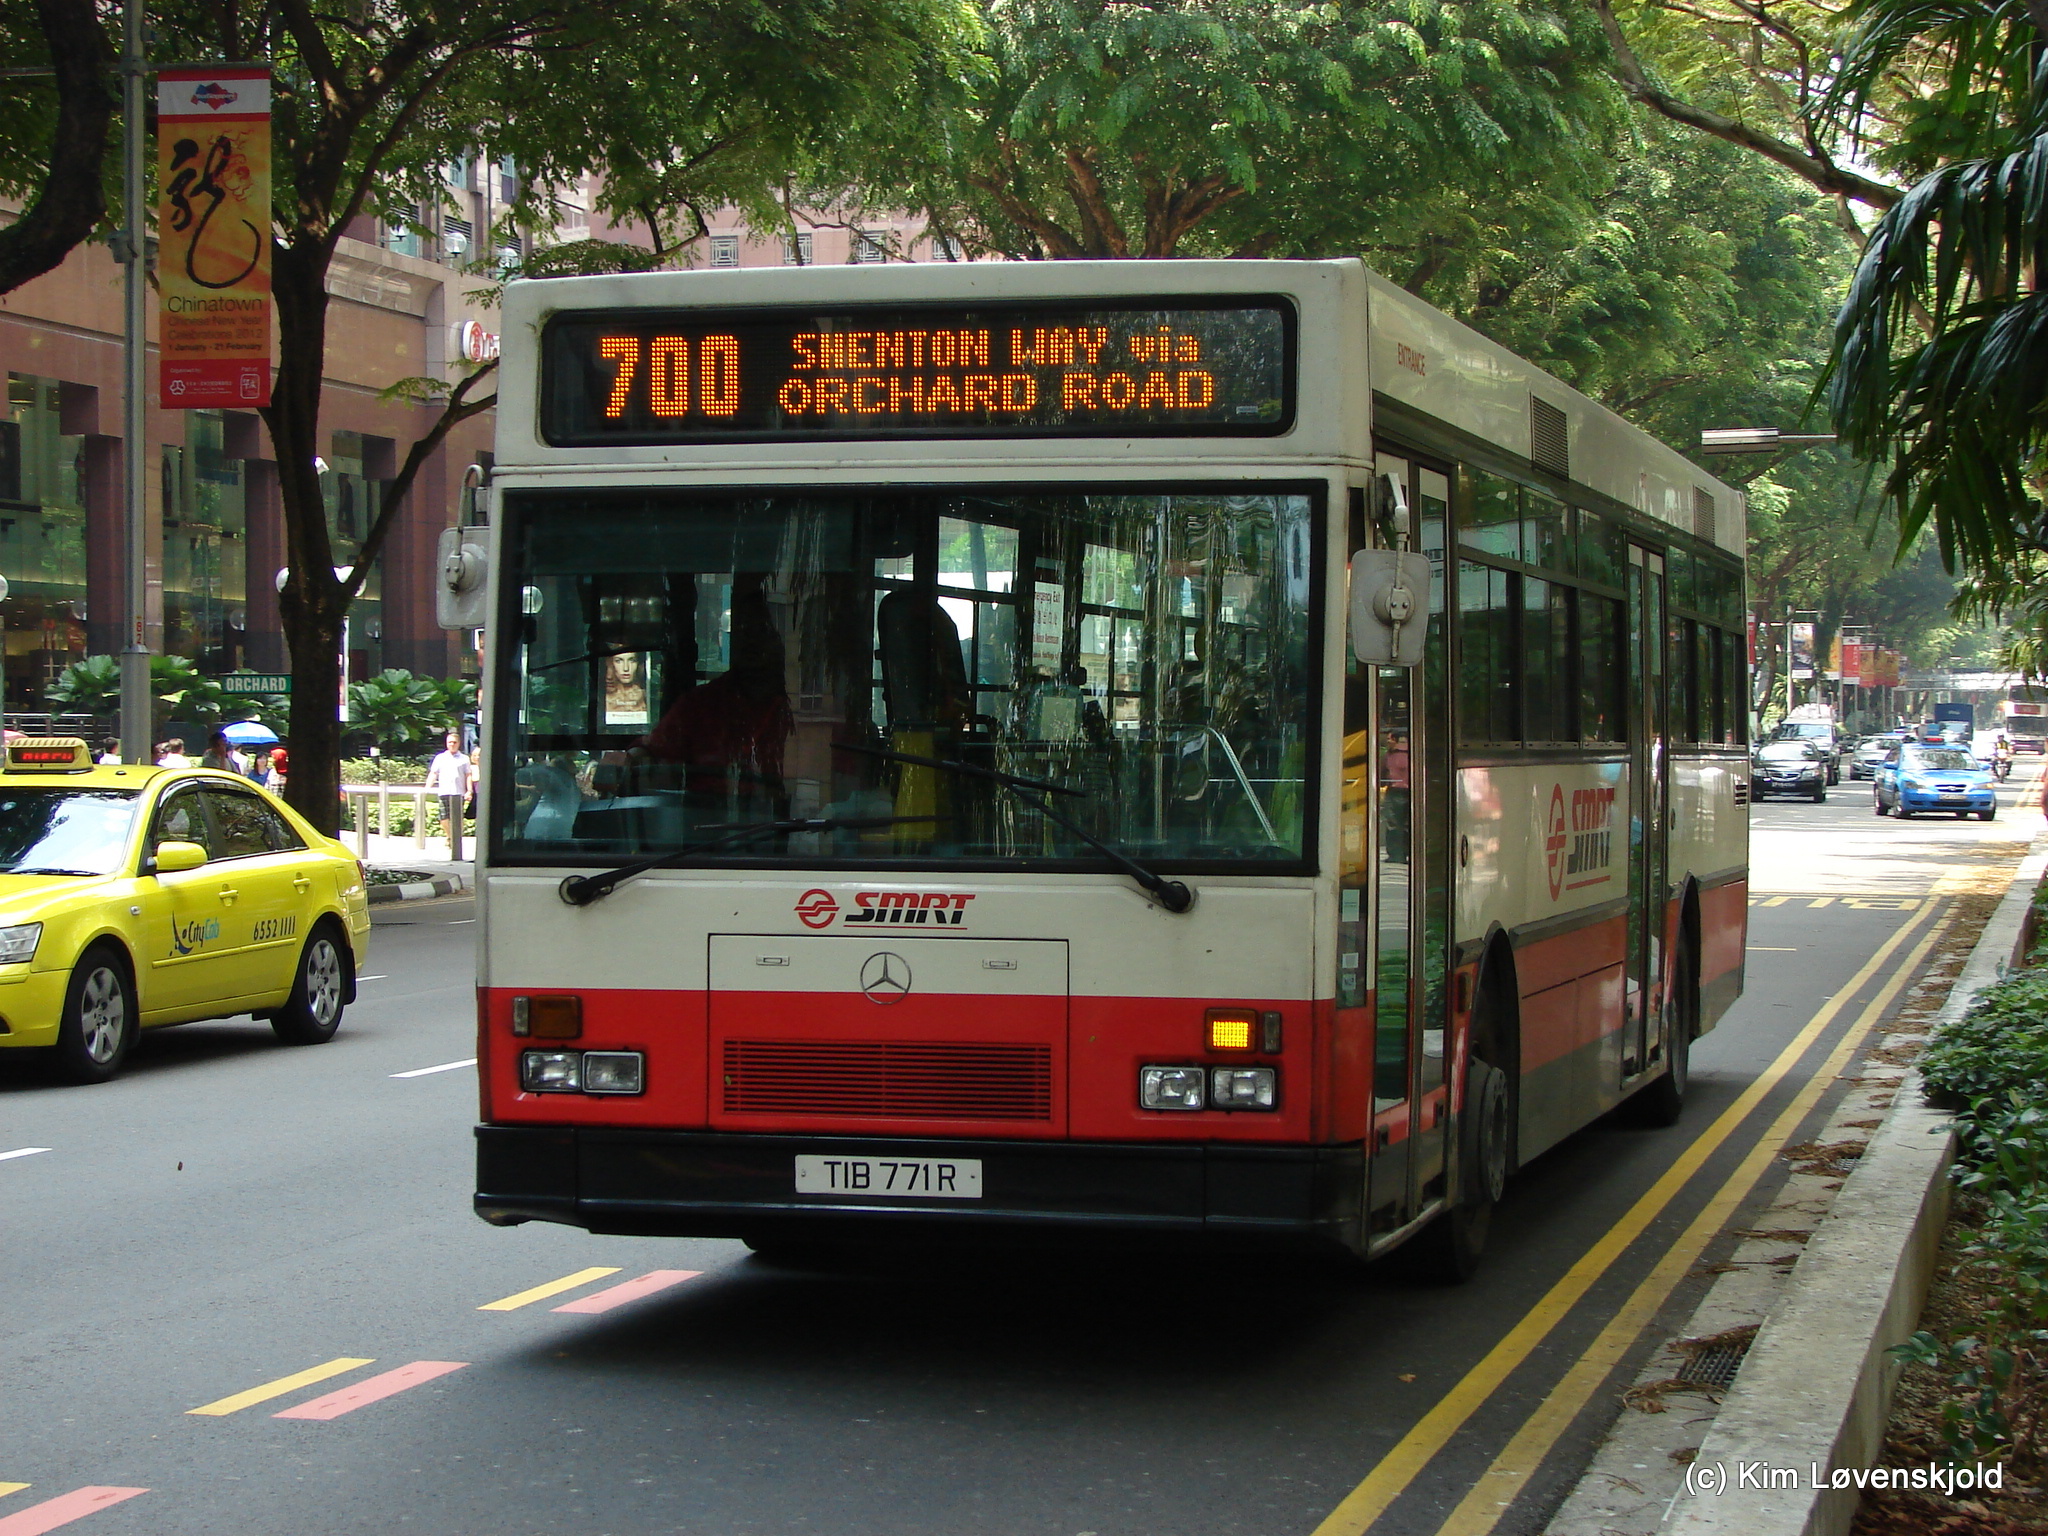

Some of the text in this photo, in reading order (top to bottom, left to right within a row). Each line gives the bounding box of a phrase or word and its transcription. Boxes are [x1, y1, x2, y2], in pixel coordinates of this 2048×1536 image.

[168, 296, 262, 313] Chinatown
[212, 315, 236, 325] New
[236, 328, 262, 339] 2012
[601, 325, 1199, 417] 700 SHENTON WAY via
[1397, 342, 1426, 377] ENTRANCE
[778, 369, 1216, 414] ORCHARD ROAD
[226, 677, 287, 692] ORCHARD
[844, 892, 976, 925] SMRT
[253, 919, 278, 941] 6552
[824, 1161, 870, 1190] TIB
